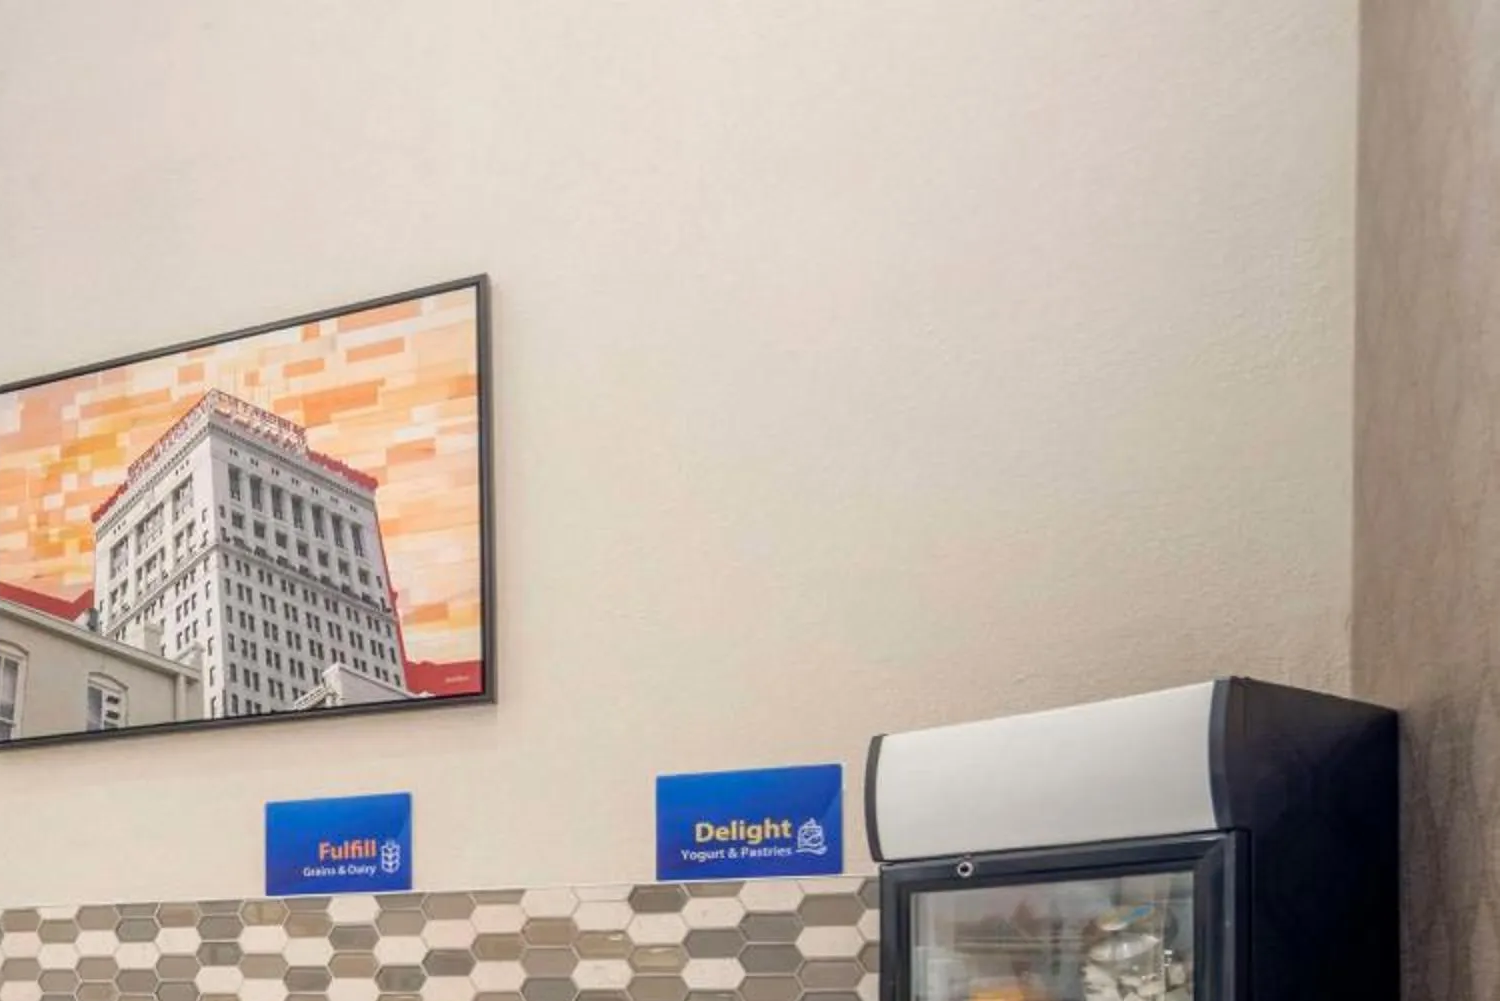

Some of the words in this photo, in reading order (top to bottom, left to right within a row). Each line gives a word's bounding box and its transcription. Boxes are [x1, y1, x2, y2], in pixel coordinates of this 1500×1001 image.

[694, 817, 793, 844] Delight
[318, 838, 377, 861] Fulfill
[680, 849, 725, 862] Yogurt
[727, 847, 738, 859] &
[741, 845, 793, 858] Pastries
[303, 866, 337, 877] Grains
[338, 865, 347, 875] &
[347, 864, 377, 877] Dairy
